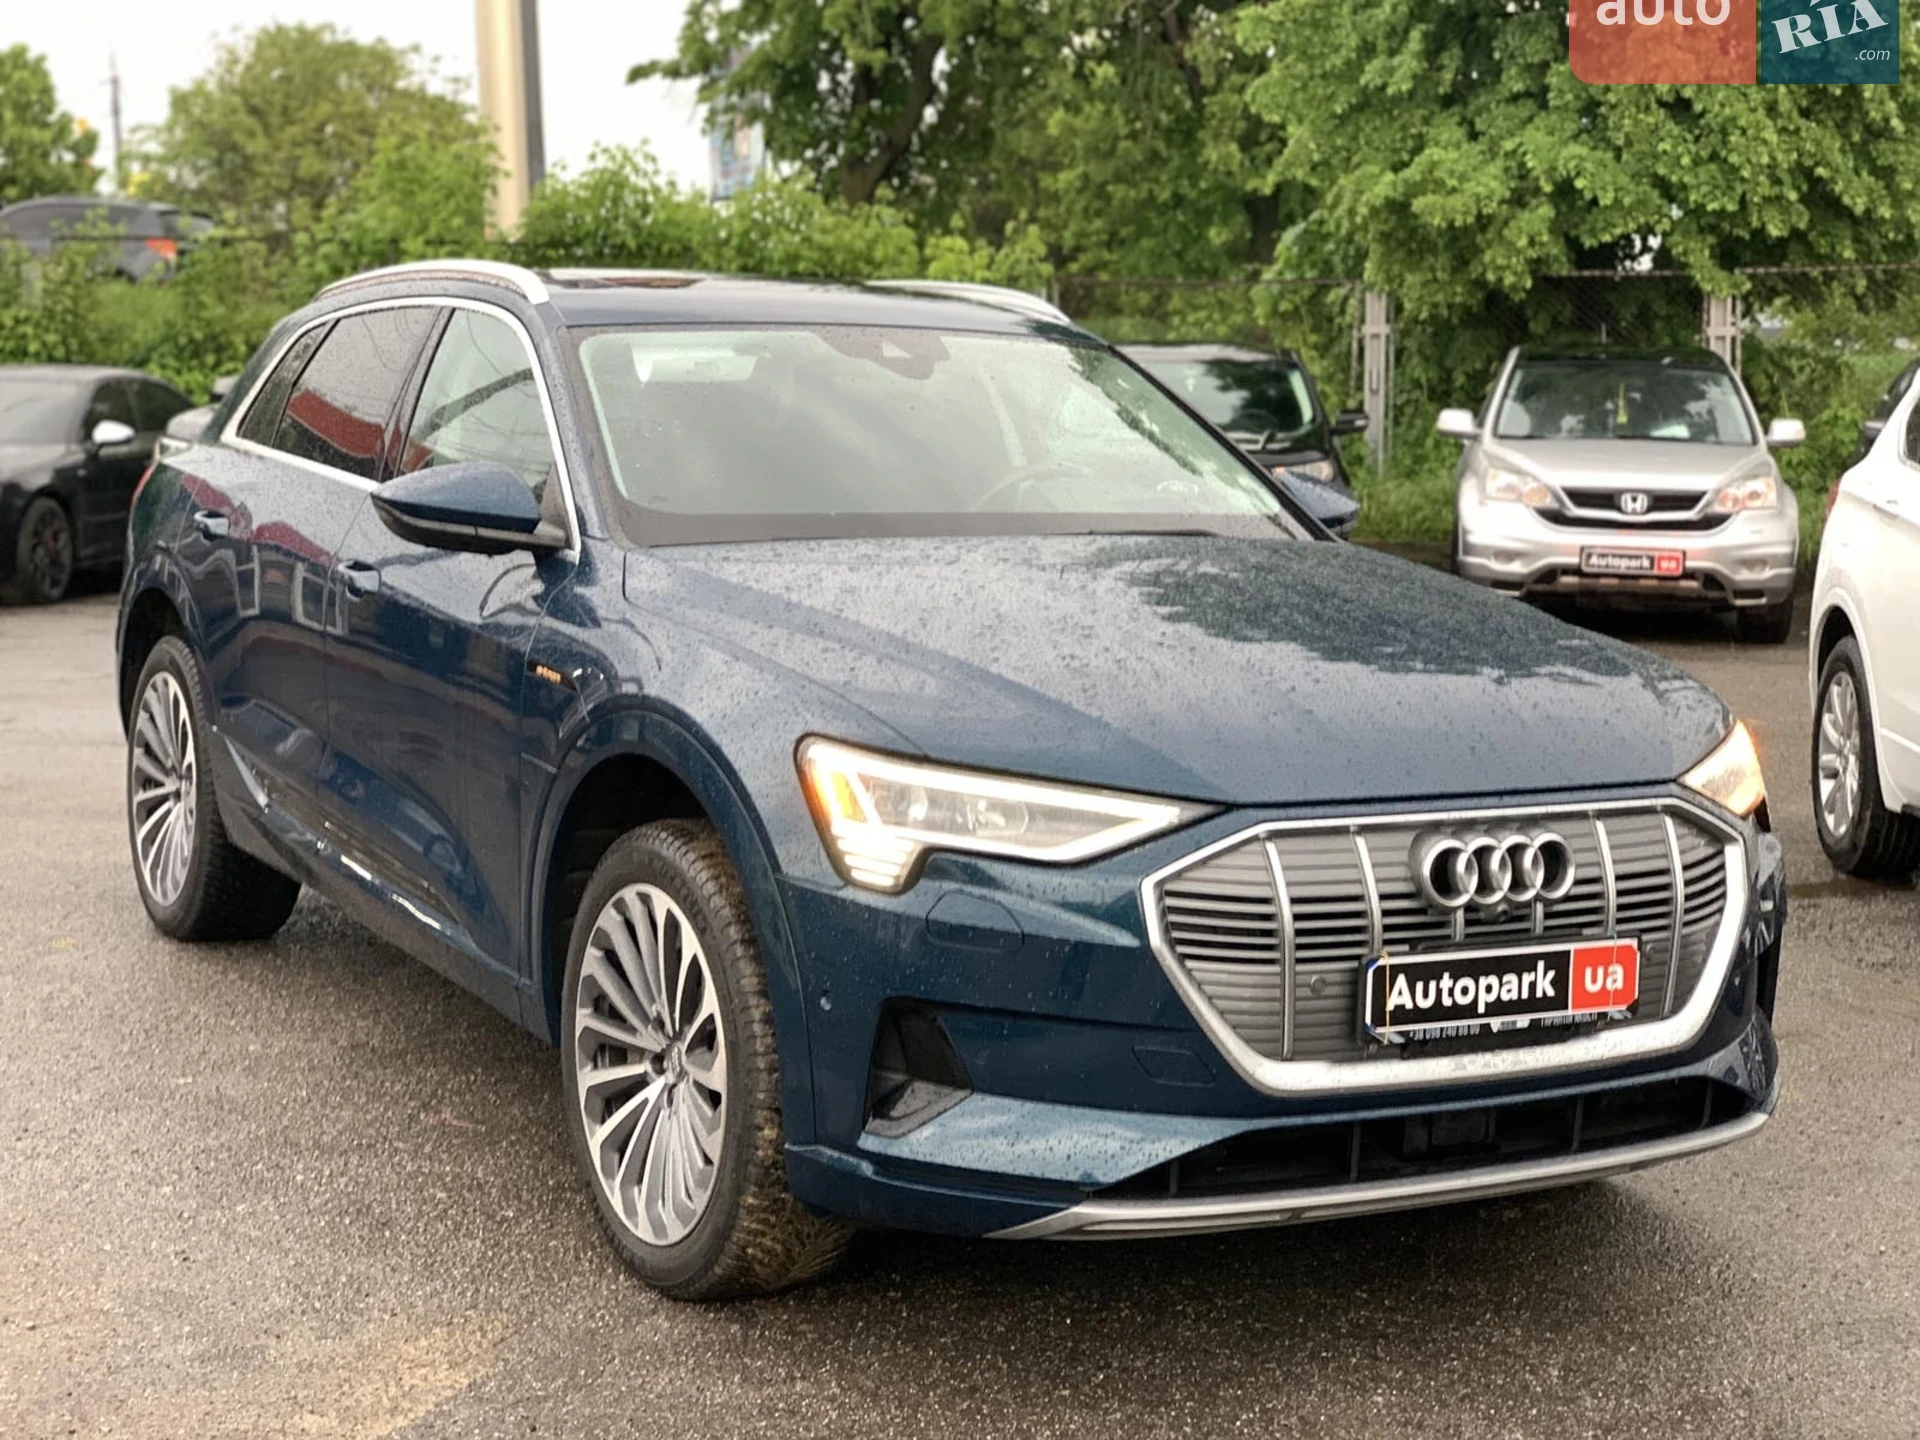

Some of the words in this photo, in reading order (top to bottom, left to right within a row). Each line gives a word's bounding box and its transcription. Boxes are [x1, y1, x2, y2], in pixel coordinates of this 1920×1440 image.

[1588, 553, 1651, 571] Autopark
[1387, 960, 1556, 1014] Autopark
[1584, 962, 1624, 994] ua
